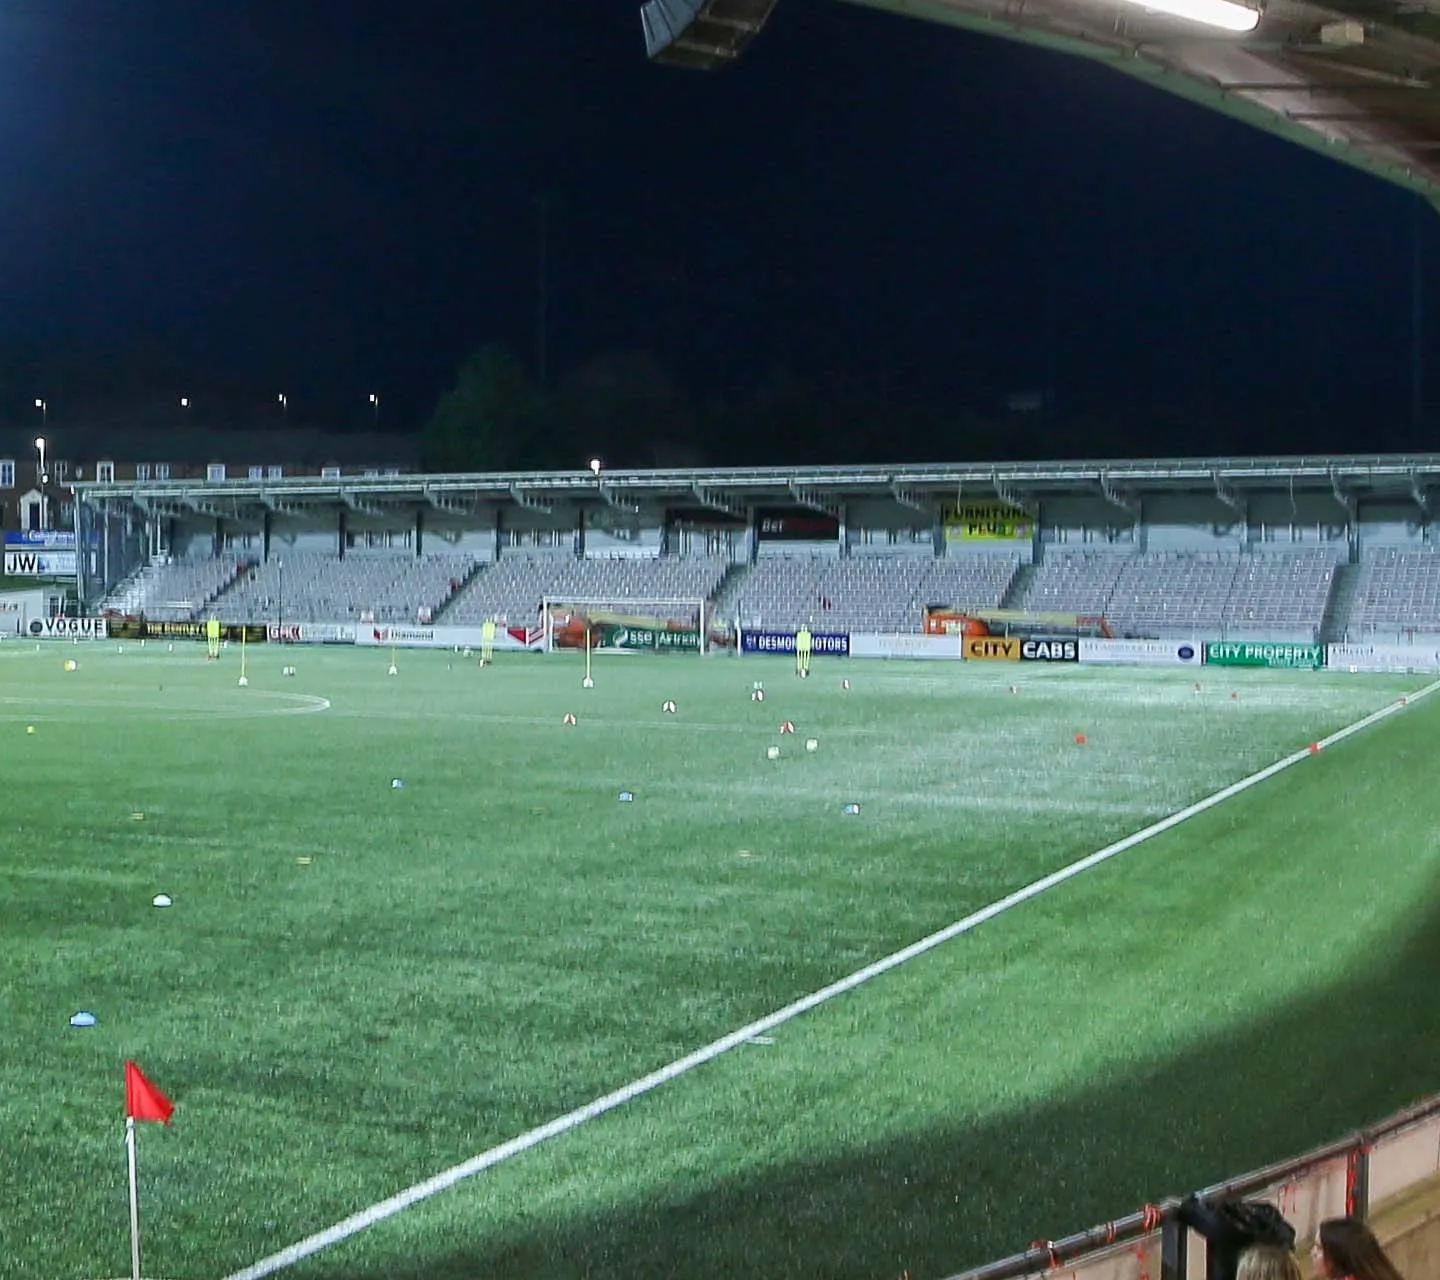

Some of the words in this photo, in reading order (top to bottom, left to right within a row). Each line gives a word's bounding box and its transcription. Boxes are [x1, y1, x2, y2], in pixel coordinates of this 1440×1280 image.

[7, 552, 37, 573] JW
[46, 618, 104, 634] VOGUE
[971, 641, 1013, 657] CITY
[1023, 641, 1075, 659] CABS
[1210, 644, 1241, 659] CITY
[1245, 644, 1321, 661] PROPERTY
